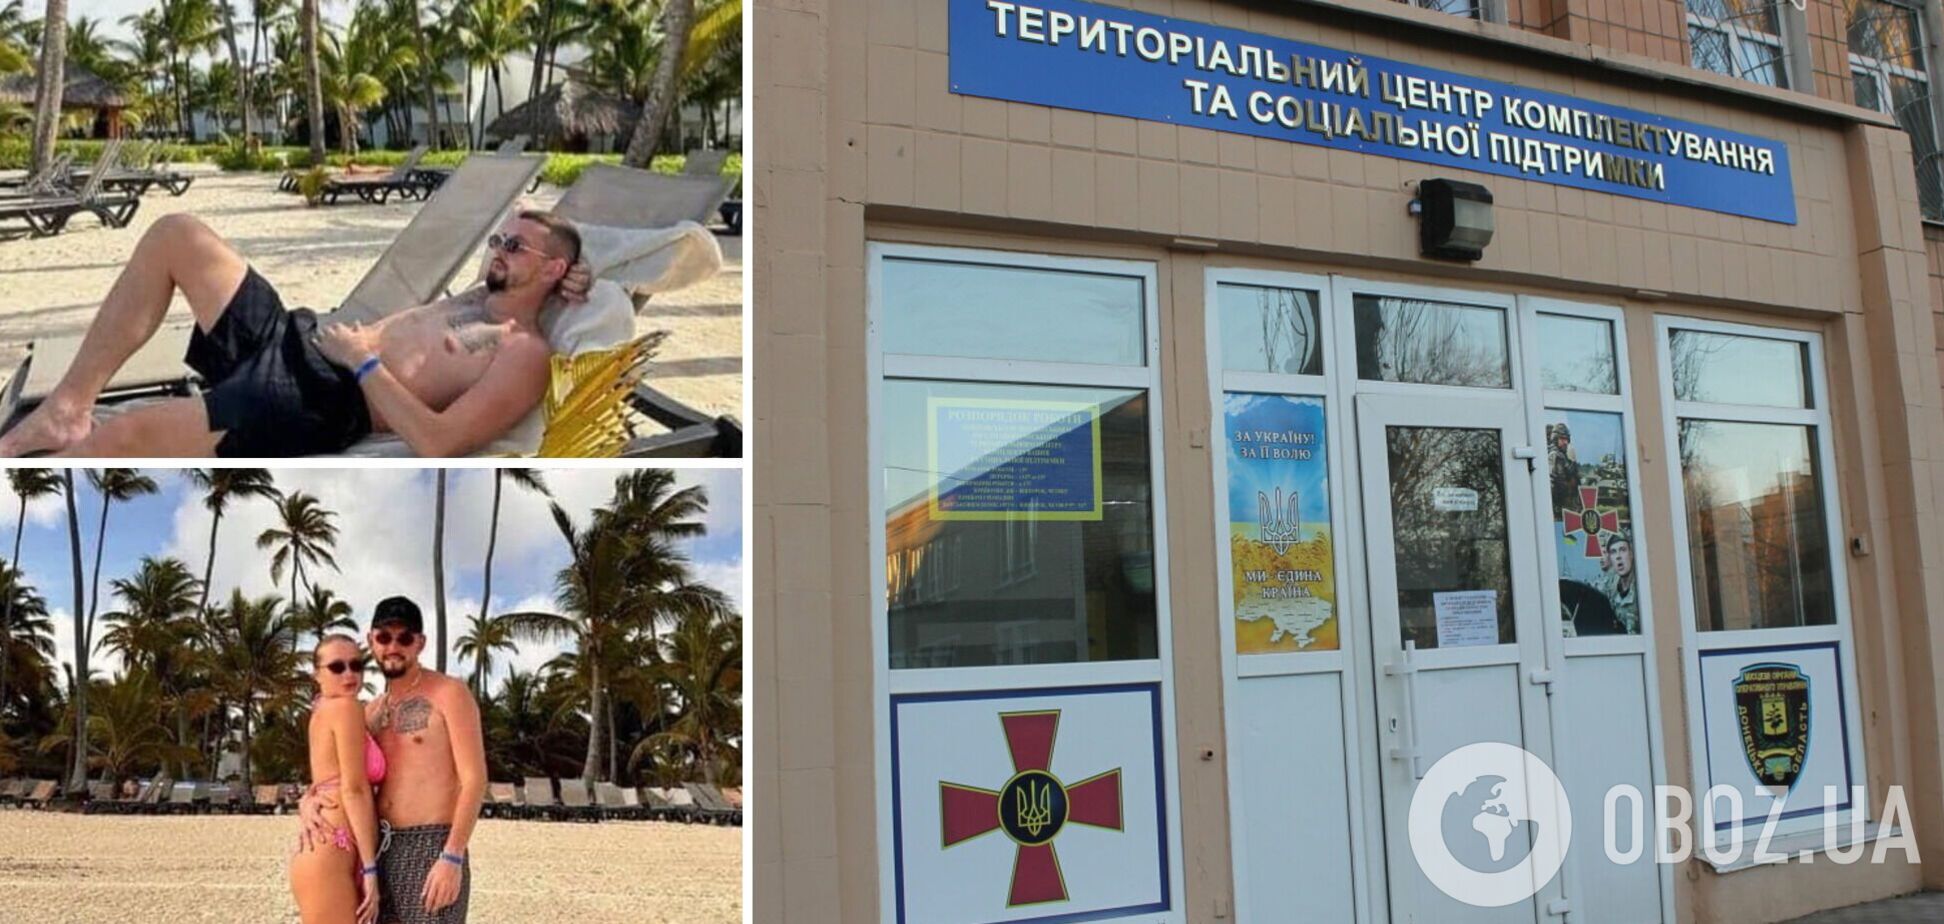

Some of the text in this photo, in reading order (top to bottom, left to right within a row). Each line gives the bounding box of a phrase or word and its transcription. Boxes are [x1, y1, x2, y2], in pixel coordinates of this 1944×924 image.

[987, 0, 1774, 175] ТЕРИТОРІАЛЬНИЙ ЦЕНТР КОМПЛЕКТУВАННЯ
[1184, 79, 1665, 191] ТА СОЦІАЛЬНОЇ ПІДТРИМКИ
[1235, 429, 1315, 444] ЗА УКРАЇНУ!
[1240, 447, 1257, 459] ЗА
[1273, 447, 1312, 460] ВОЛЮ
[1245, 571, 1266, 582] МИ
[1277, 570, 1322, 583] ЄДИНА
[1262, 585, 1312, 598] КРАЇНА
[1738, 705, 1765, 777] ДОНЕЦЬКА
[1792, 702, 1809, 774] ОБЛАСТЬ
